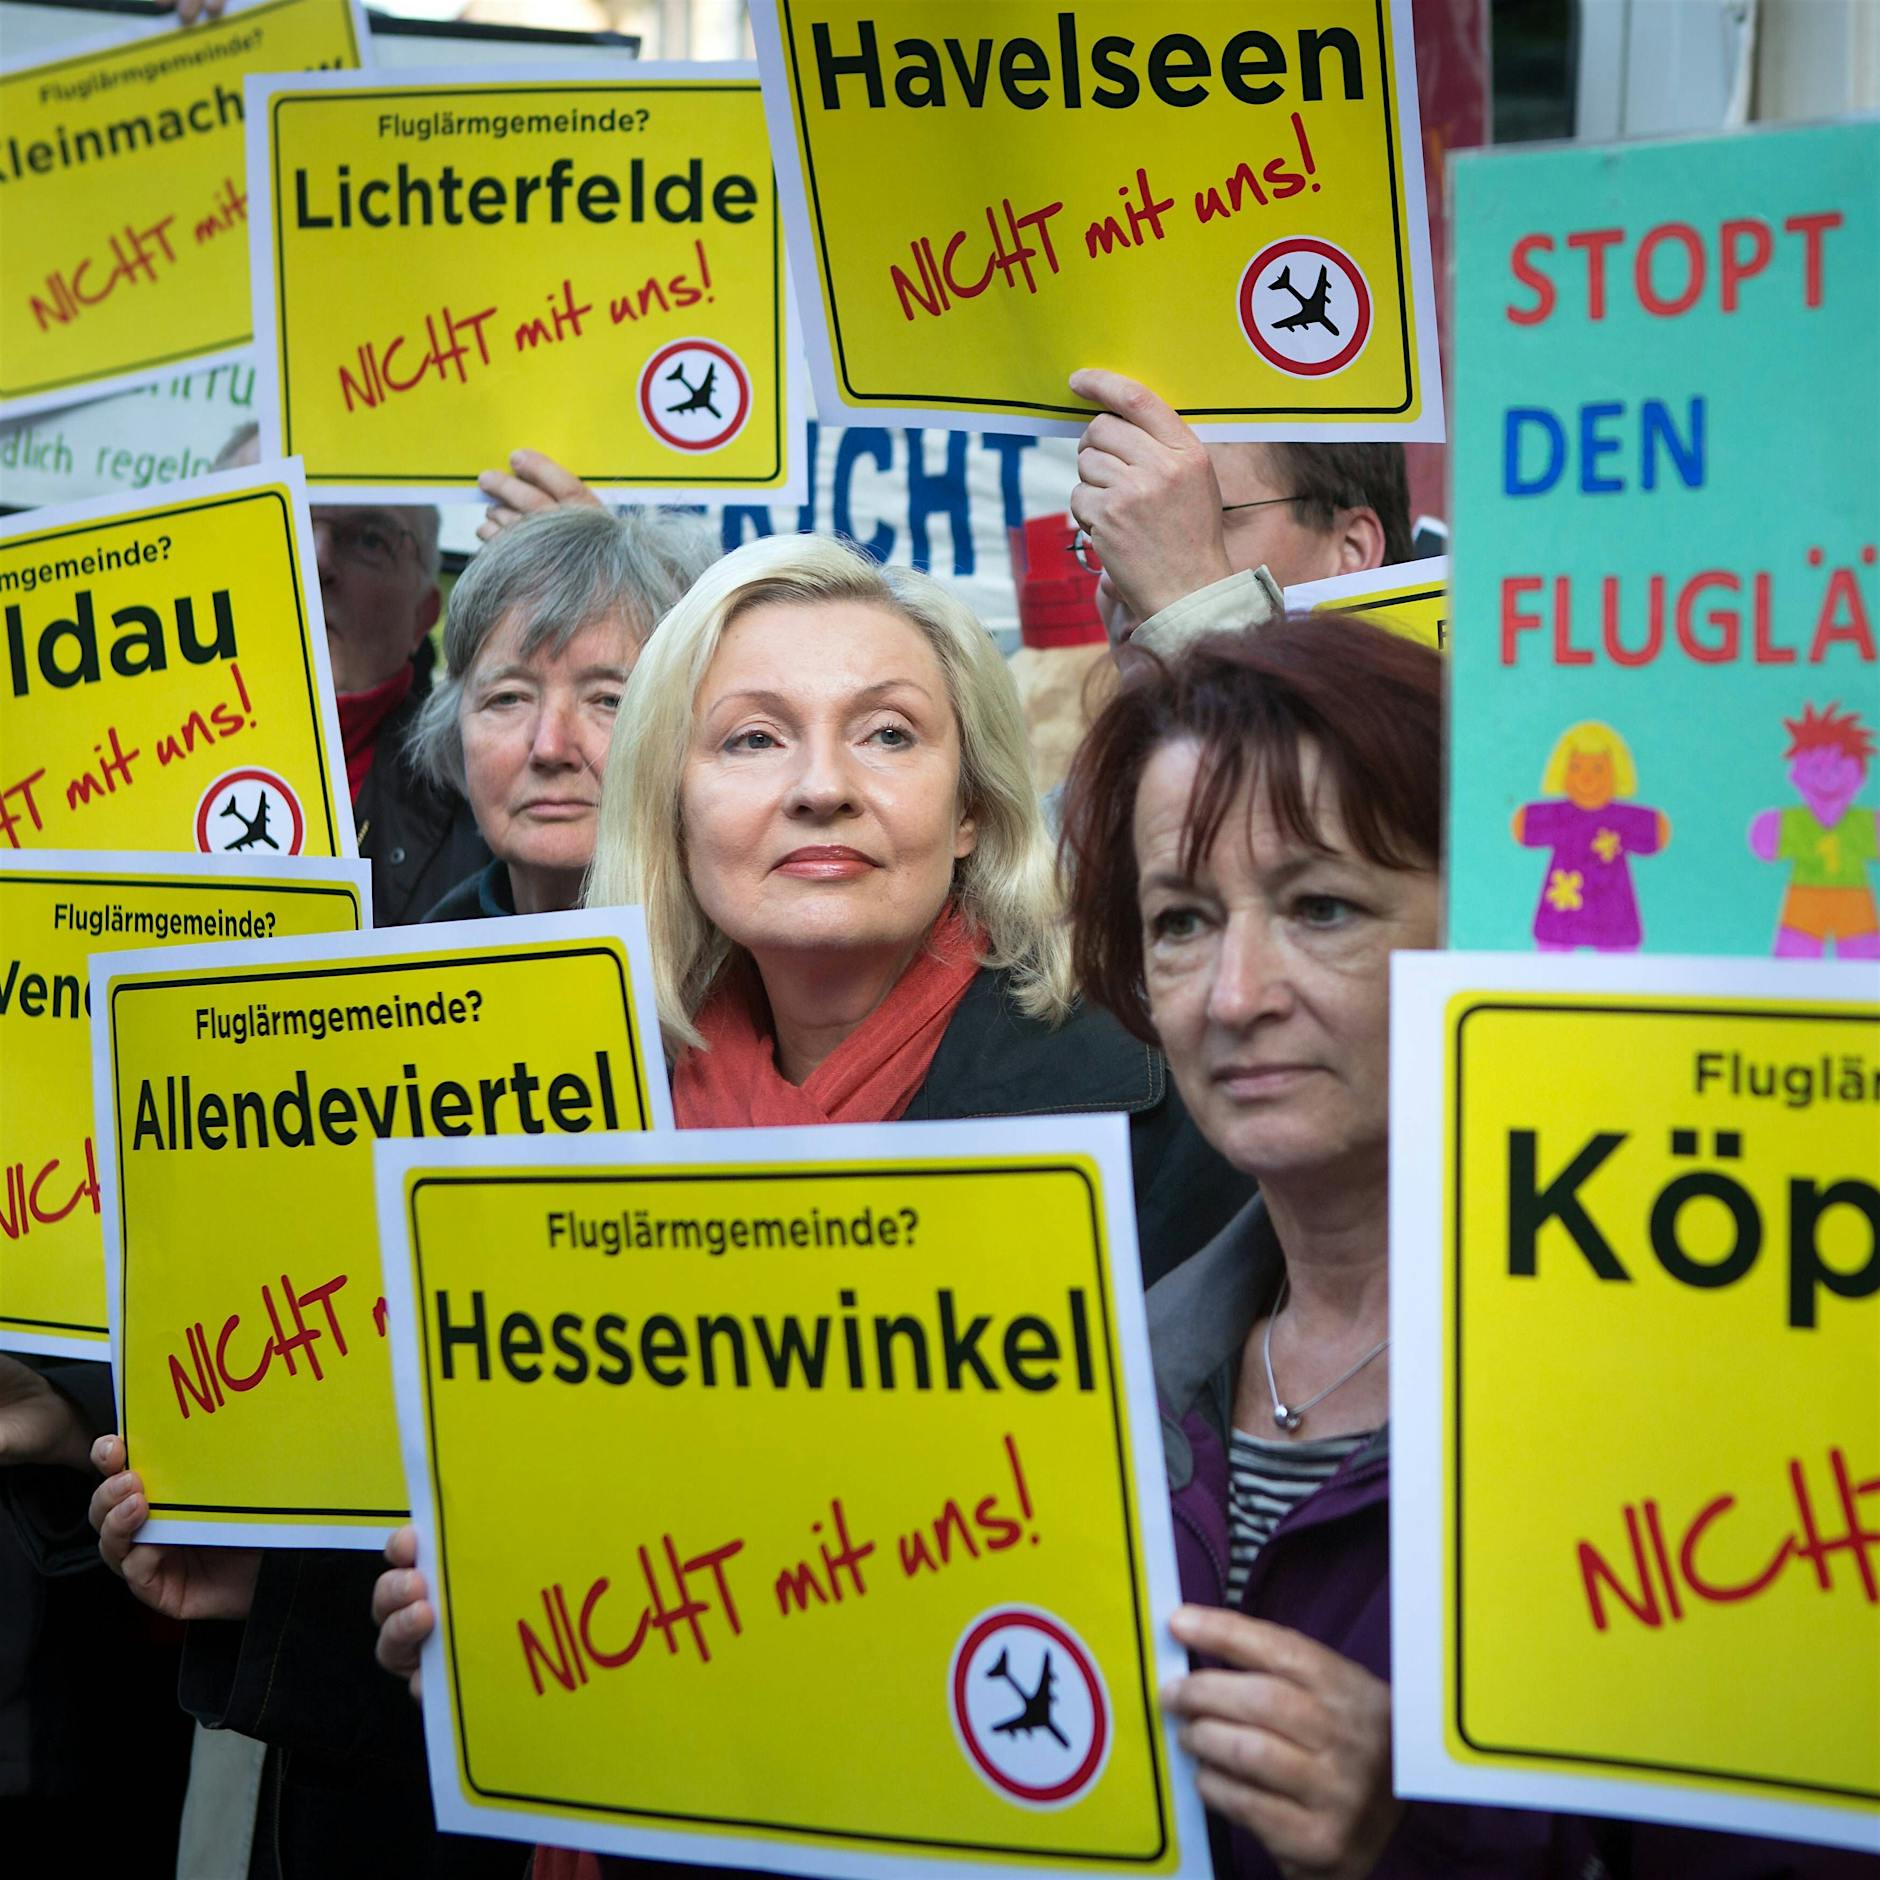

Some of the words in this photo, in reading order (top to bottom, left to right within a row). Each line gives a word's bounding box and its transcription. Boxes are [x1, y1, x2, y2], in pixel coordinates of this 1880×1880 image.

[811, 12, 1364, 111] Havelseen
[379, 109, 649, 141] Fluglärmgemeinde?
[295, 159, 757, 229] Lichterfelde
[890, 200, 1063, 320] NICHT
[1084, 168, 1175, 257] mit
[1194, 112, 1321, 224] uns!
[30, 219, 174, 329] NICHT
[1508, 214, 1840, 324] STOPT
[339, 307, 496, 411] NICHT
[514, 280, 592, 351] mit
[610, 240, 714, 324] uns!
[1505, 397, 1704, 496] DEN
[5, 590, 237, 698] ldau
[1502, 548, 1875, 666] FLUGLÄ
[66, 726, 140, 811] mit
[155, 662, 256, 767] uns!
[55, 904, 275, 939] Fluglärmgemeinde?
[196, 990, 482, 1044] Fluglärmgemeinde?
[133, 1051, 619, 1150] Allendeviertel
[548, 1208, 918, 1256] Fluglärmgemeinde?
[1508, 1129, 1880, 1330] Köp
[168, 1274, 348, 1418] NICHT
[435, 1288, 1095, 1393] Hessenwinkel
[517, 1536, 743, 1695] NICHT
[775, 1499, 875, 1615] mit
[898, 1434, 1039, 1577] uns!
